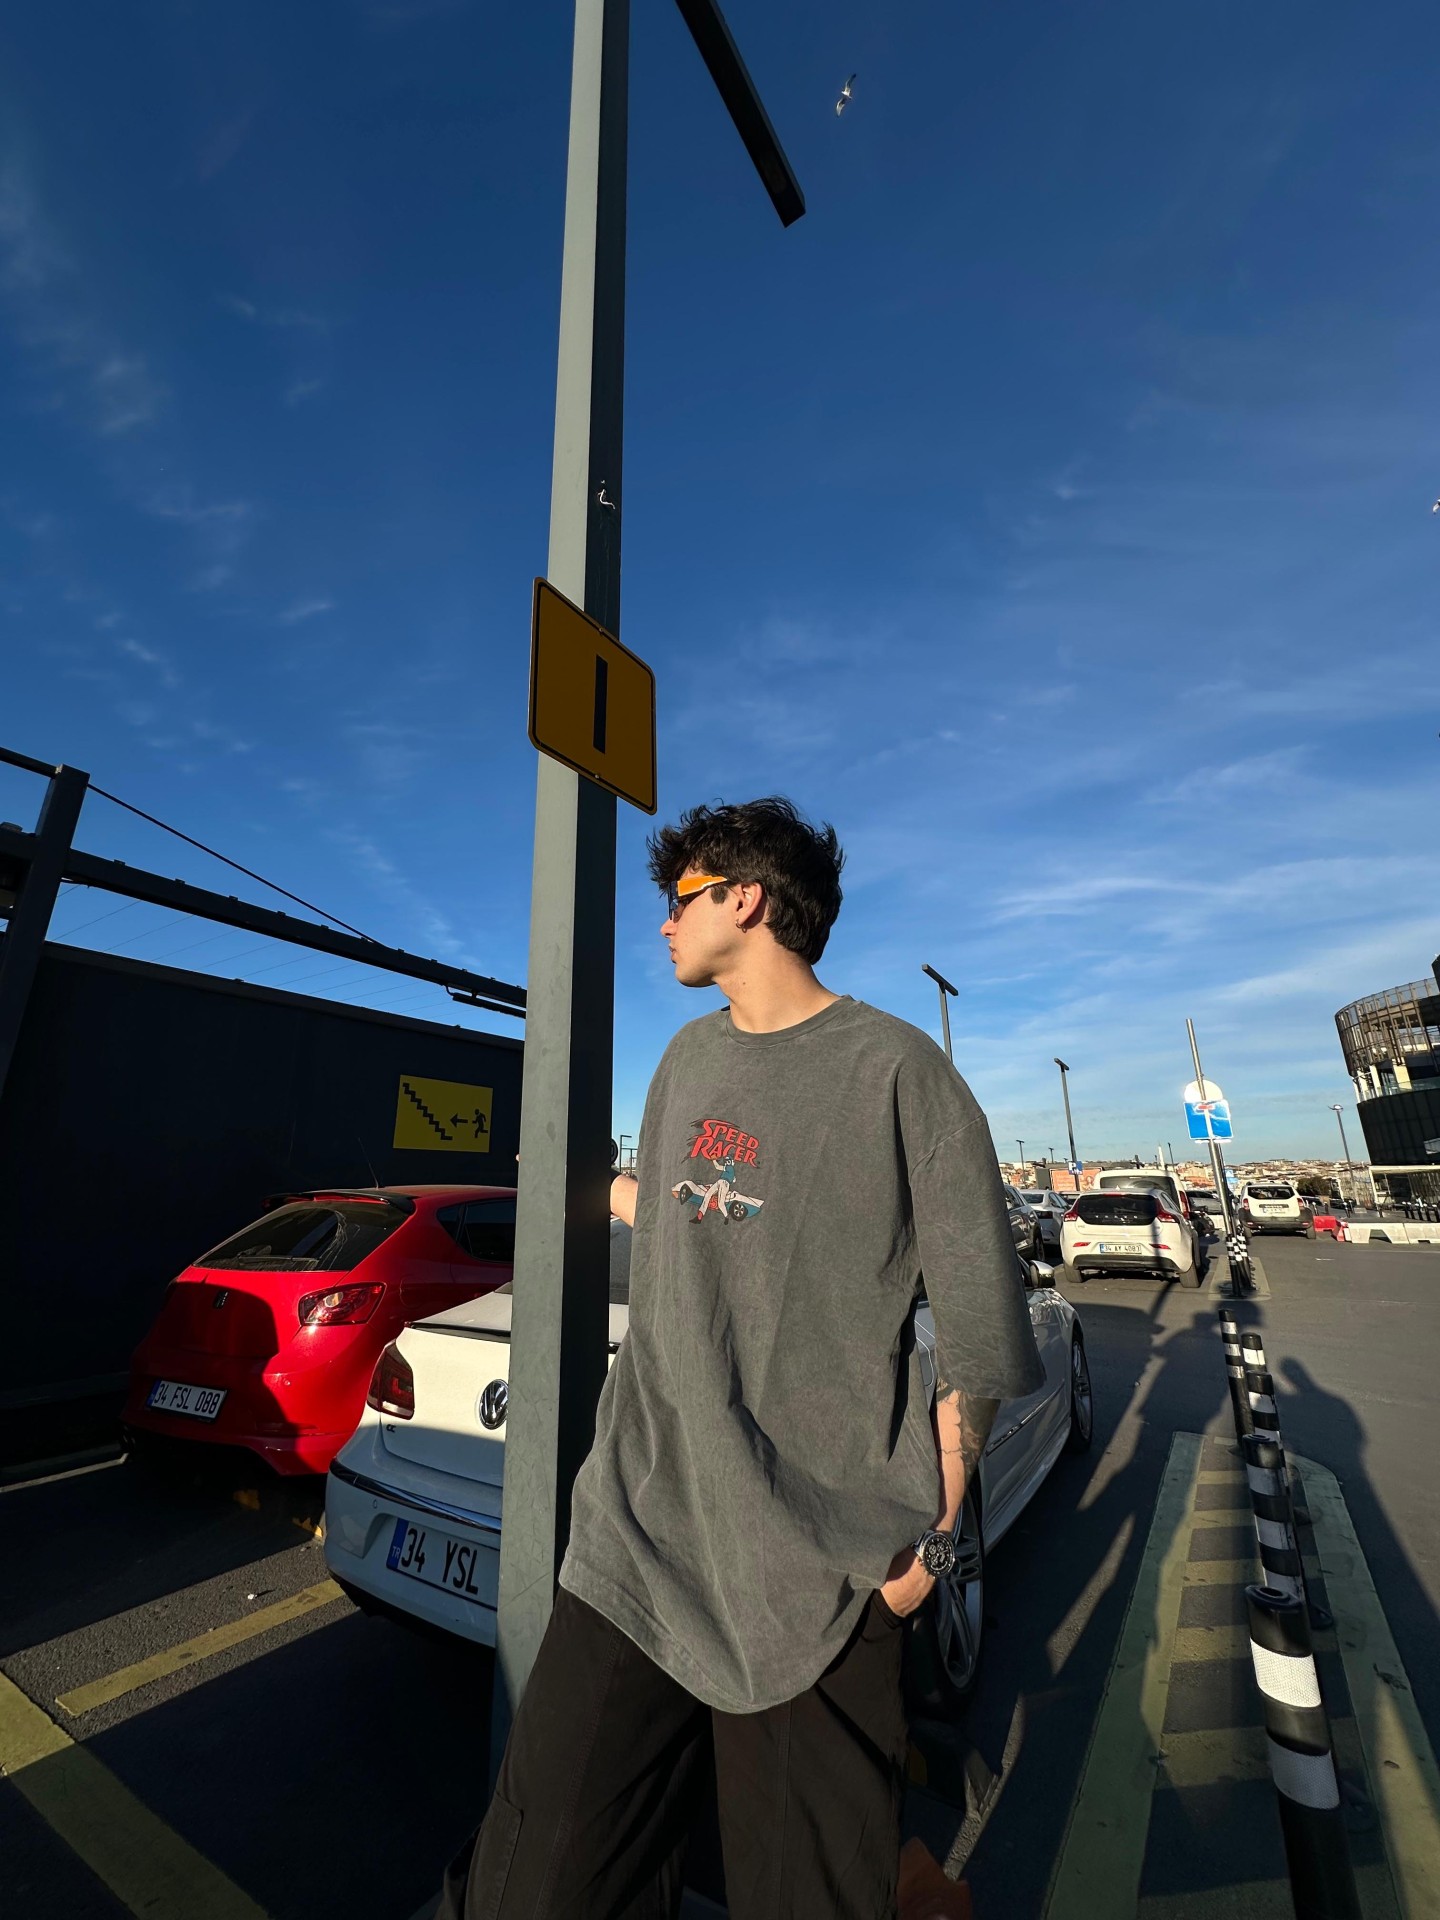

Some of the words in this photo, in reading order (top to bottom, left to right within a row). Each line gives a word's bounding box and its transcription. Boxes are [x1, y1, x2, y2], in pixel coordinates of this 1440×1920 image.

[703, 1118, 759, 1150] SPEED
[690, 1135, 758, 1168] RACER
[154, 1383, 170, 1404] 34
[170, 1387, 192, 1410] FSL
[195, 1391, 220, 1414] 088
[391, 1545, 401, 1559] TR
[401, 1527, 426, 1573] 34
[442, 1540, 479, 1595] YSL
